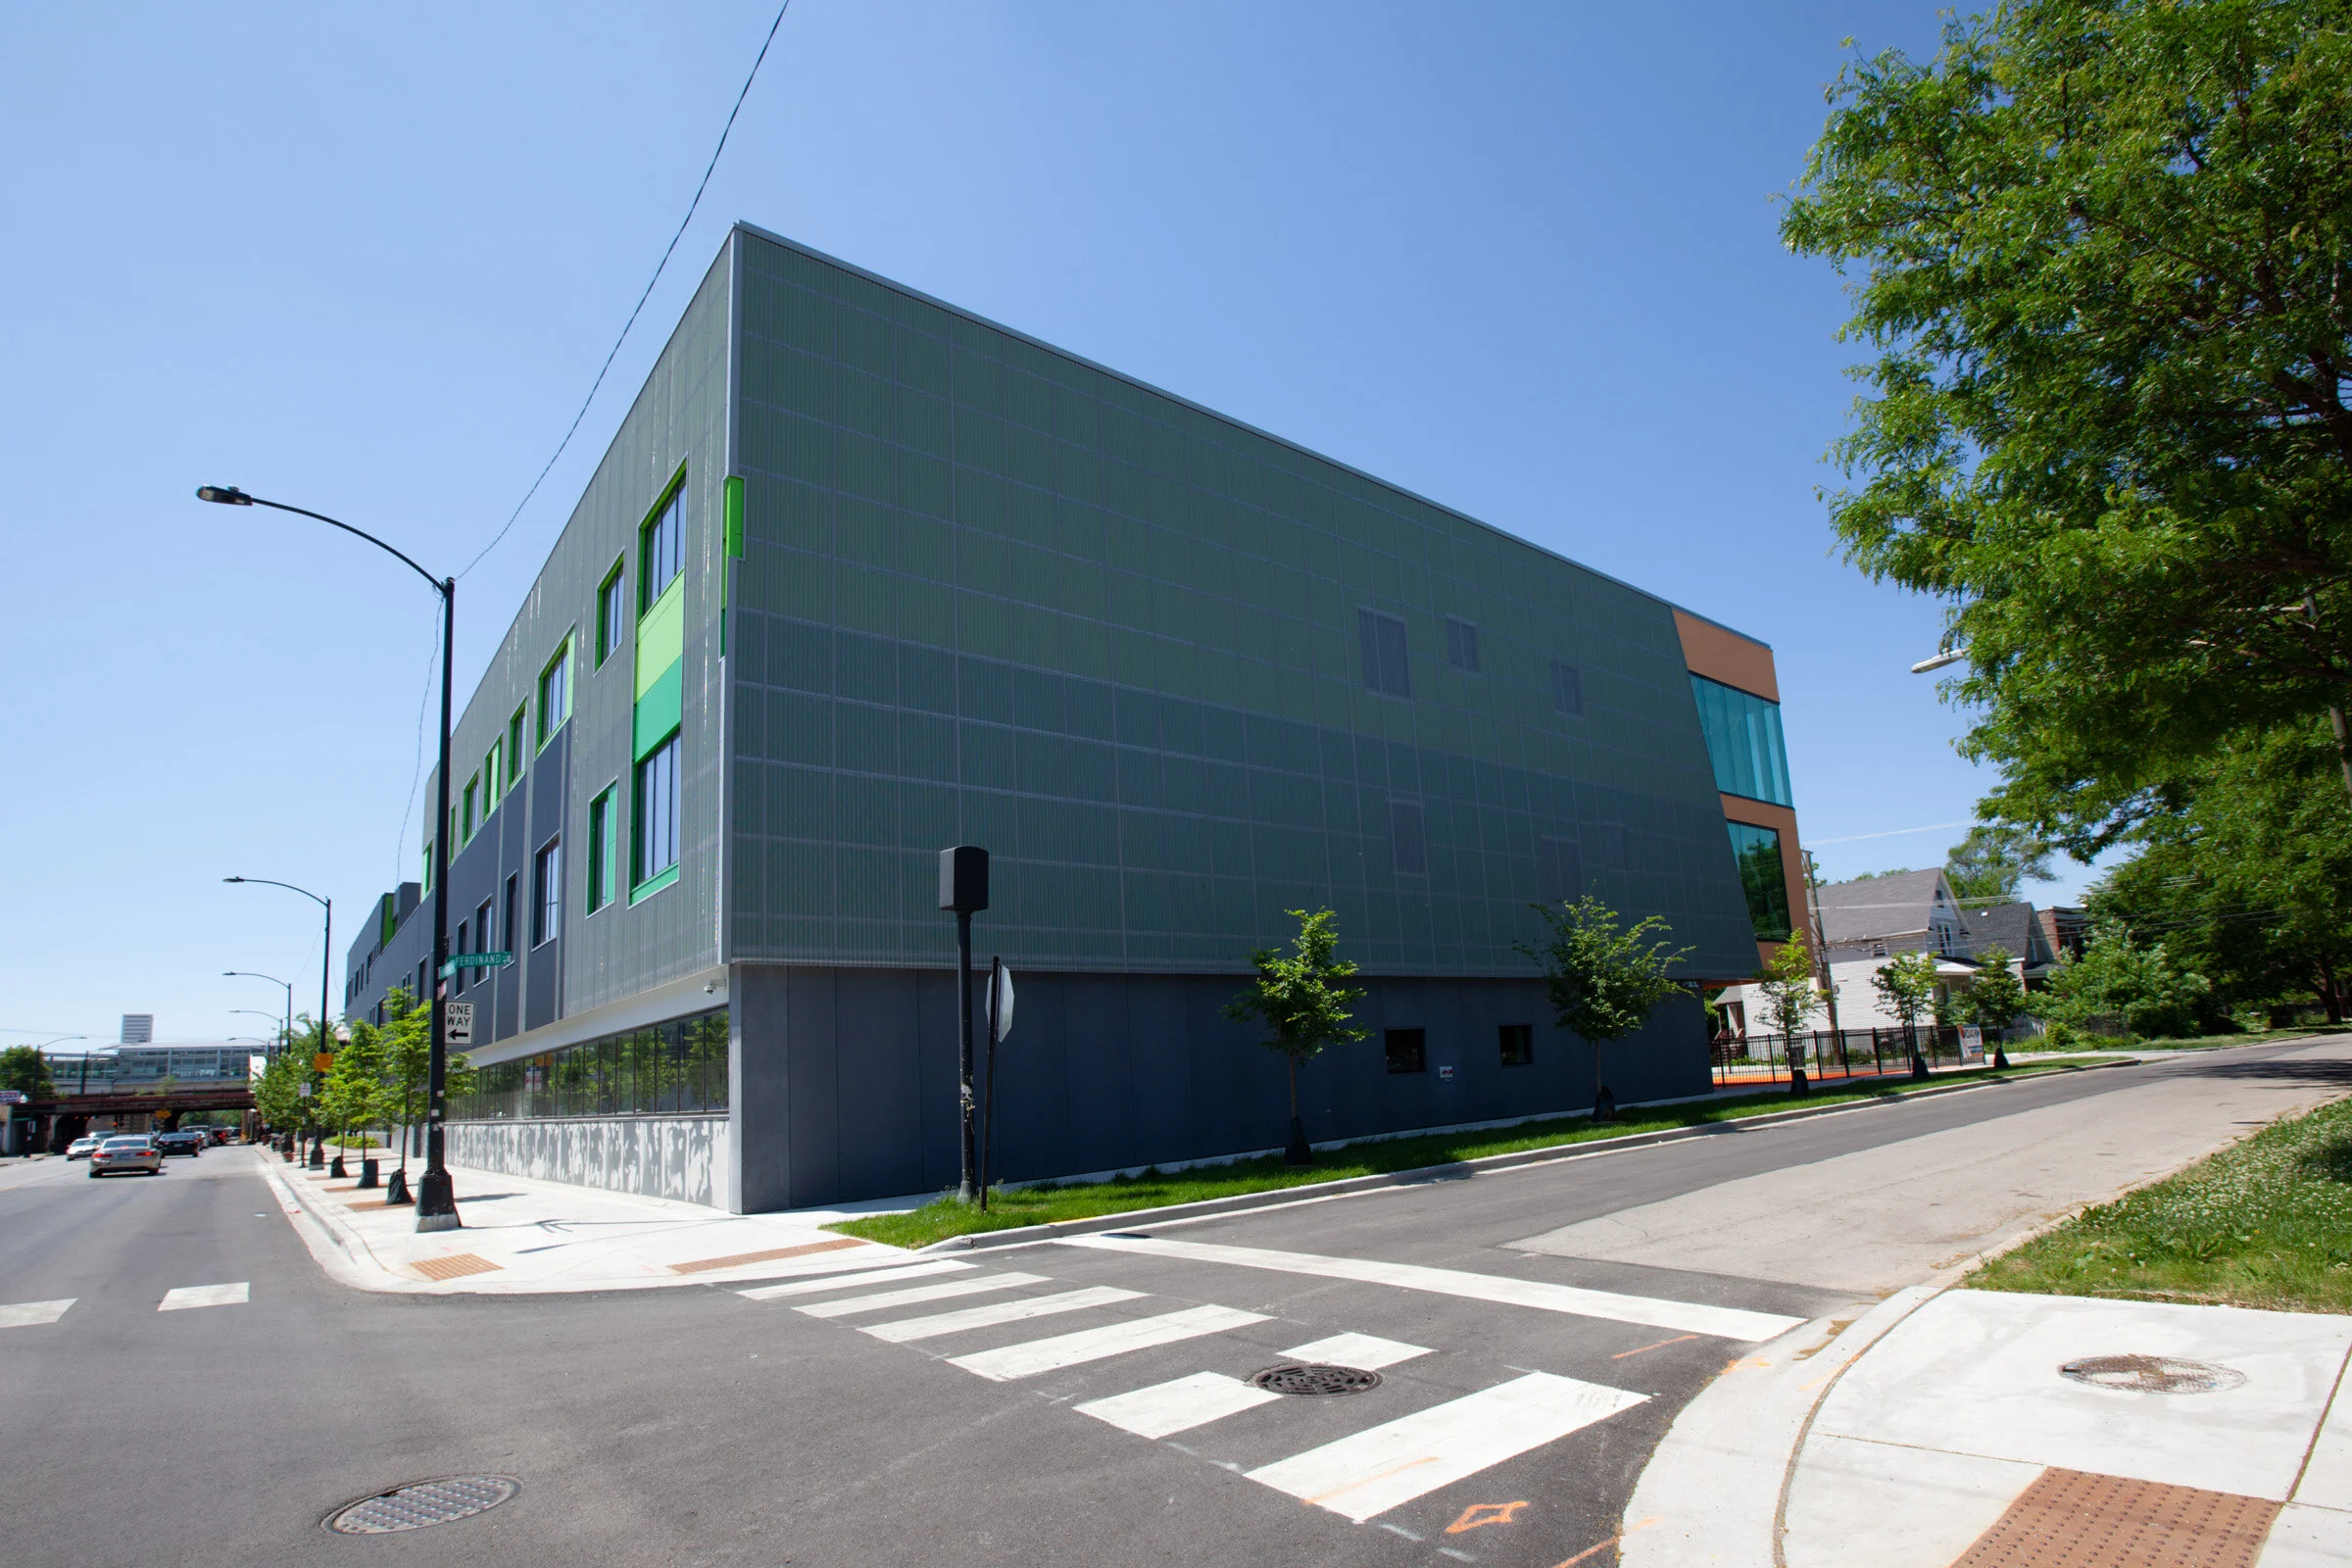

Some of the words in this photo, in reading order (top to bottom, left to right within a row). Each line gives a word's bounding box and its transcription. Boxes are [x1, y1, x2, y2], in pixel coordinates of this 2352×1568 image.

[455, 955, 501, 966] FERDINAND
[448, 1004, 470, 1015] ONE
[447, 1016, 470, 1027] WAY
